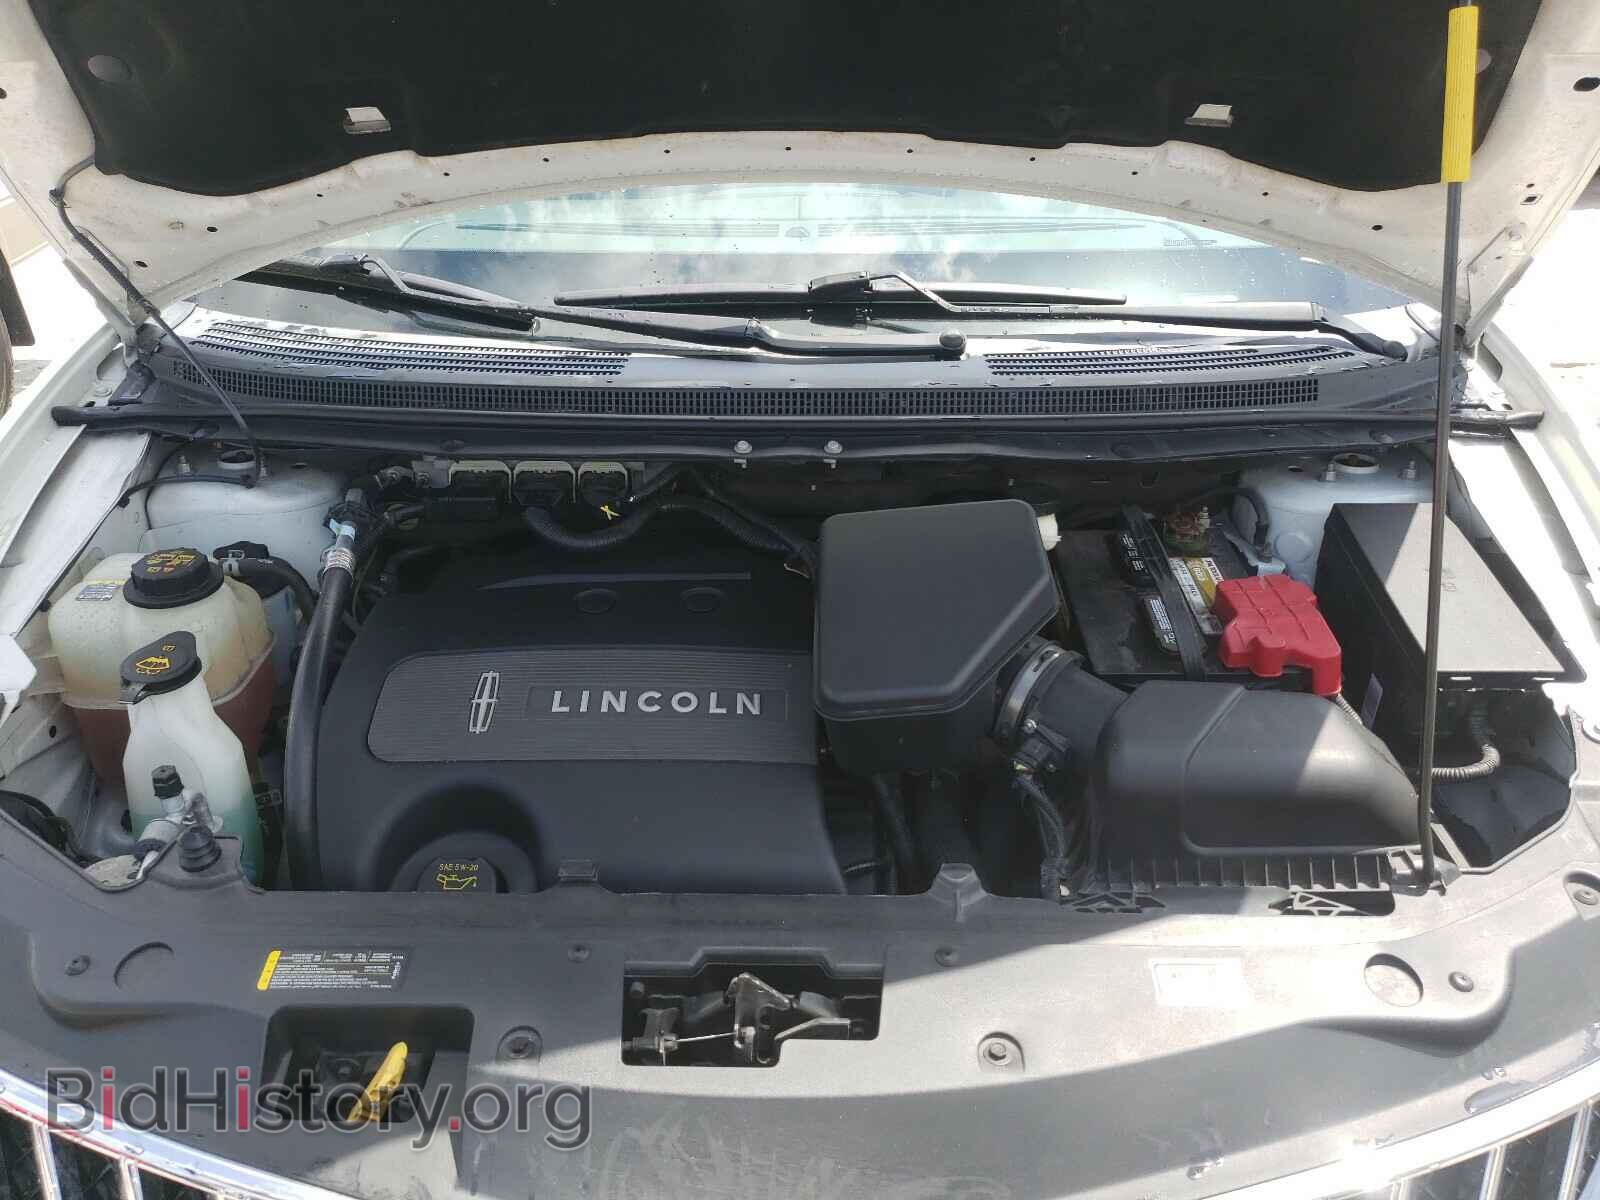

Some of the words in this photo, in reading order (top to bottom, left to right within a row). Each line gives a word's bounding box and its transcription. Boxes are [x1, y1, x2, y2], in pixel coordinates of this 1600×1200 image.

[551, 690, 761, 715] LINCOLN
[440, 863, 454, 871] SAE
[454, 863, 479, 871] 5W-20
